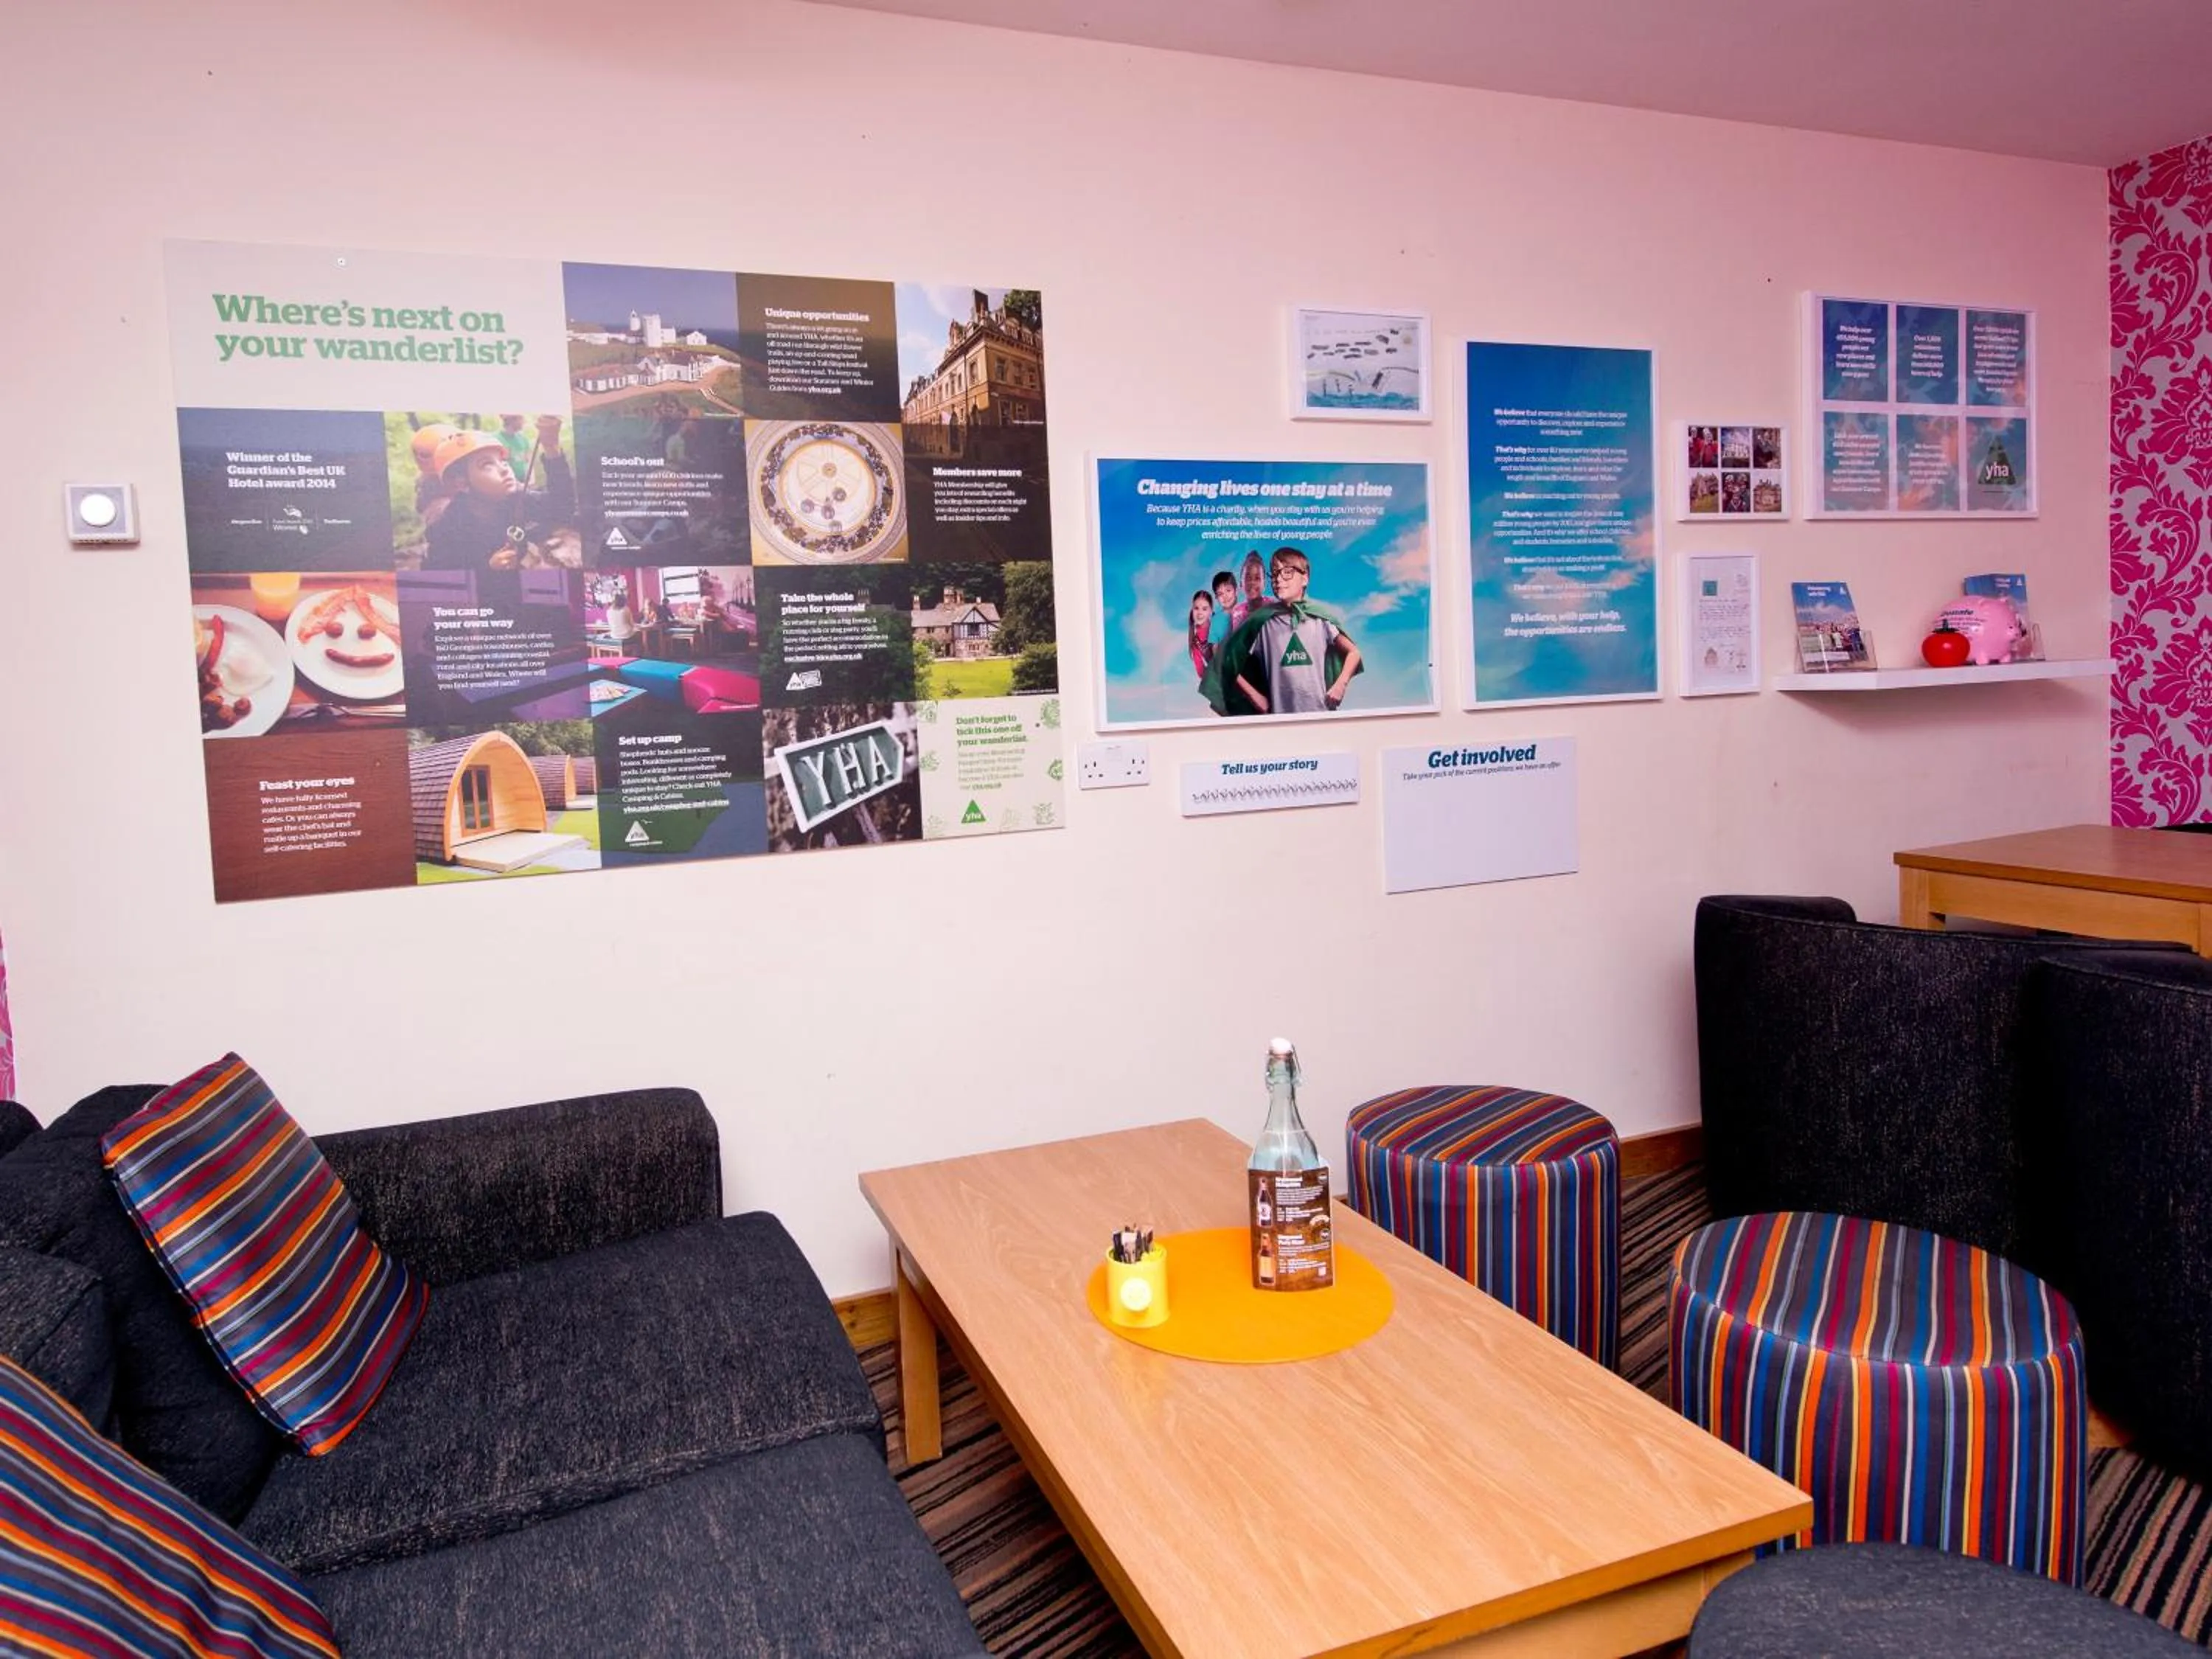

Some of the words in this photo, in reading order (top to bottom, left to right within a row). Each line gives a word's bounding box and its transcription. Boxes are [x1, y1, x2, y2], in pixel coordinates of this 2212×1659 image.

[212, 293, 366, 327] Where's
[372, 306, 454, 331] next
[459, 310, 505, 333] on
[765, 307, 801, 319] Unique
[802, 309, 869, 322] opportunities
[215, 335, 307, 361] your
[314, 336, 524, 365] wanderlist?
[226, 452, 274, 462] Winner
[277, 452, 290, 462] of
[291, 452, 312, 462] the
[601, 456, 644, 466] School's
[646, 458, 664, 466] out
[227, 465, 296, 476] Guardian's
[298, 466, 325, 475] Best
[326, 466, 346, 476] UK
[933, 467, 976, 476] Members
[1986, 462, 2009, 479] yha
[228, 479, 263, 487] Hotel
[265, 479, 305, 488] award
[307, 479, 336, 488] 2014
[1137, 479, 1218, 498] Changing
[1220, 479, 1259, 496] lives
[1260, 483, 1290, 496] one
[1292, 481, 1326, 499] stay
[1327, 482, 1345, 496] at
[1345, 484, 1355, 496] a
[1357, 481, 1392, 497] time
[1147, 504, 1180, 513] Because
[1183, 504, 1201, 513] YHA
[1203, 504, 1209, 513] is
[1217, 504, 1247, 515] charity,
[1270, 507, 1284, 515] you
[1304, 505, 1321, 514] with
[1157, 517, 1165, 526] to
[1166, 517, 1186, 527] keep
[1186, 518, 1211, 528] prices
[780, 594, 805, 602] Take
[807, 594, 823, 602] the
[824, 593, 854, 602] whole
[432, 607, 456, 617] You
[480, 608, 494, 616] go
[782, 605, 808, 616] place
[810, 605, 824, 613] for
[825, 603, 866, 613] yourself
[434, 621, 462, 630] your
[490, 619, 514, 629] way
[1286, 650, 1307, 664] yha
[981, 716, 1007, 724] forget
[956, 728, 973, 736] tick
[1011, 724, 1022, 732] off
[619, 736, 636, 745] Set
[637, 737, 652, 745] up
[653, 735, 682, 744] camp
[957, 739, 977, 747] your
[1427, 749, 1460, 768] Get
[1461, 744, 1537, 766] involved
[800, 736, 892, 804] YHA
[1222, 763, 1243, 775] Tell
[1245, 764, 1259, 773] us
[1260, 762, 1287, 775] your
[1288, 759, 1318, 771] story
[1402, 773, 1417, 781] Take
[1447, 769, 1455, 777] of
[1455, 768, 1464, 776] the
[260, 780, 293, 790] Feast
[295, 780, 324, 790] your
[326, 776, 355, 787] eyes
